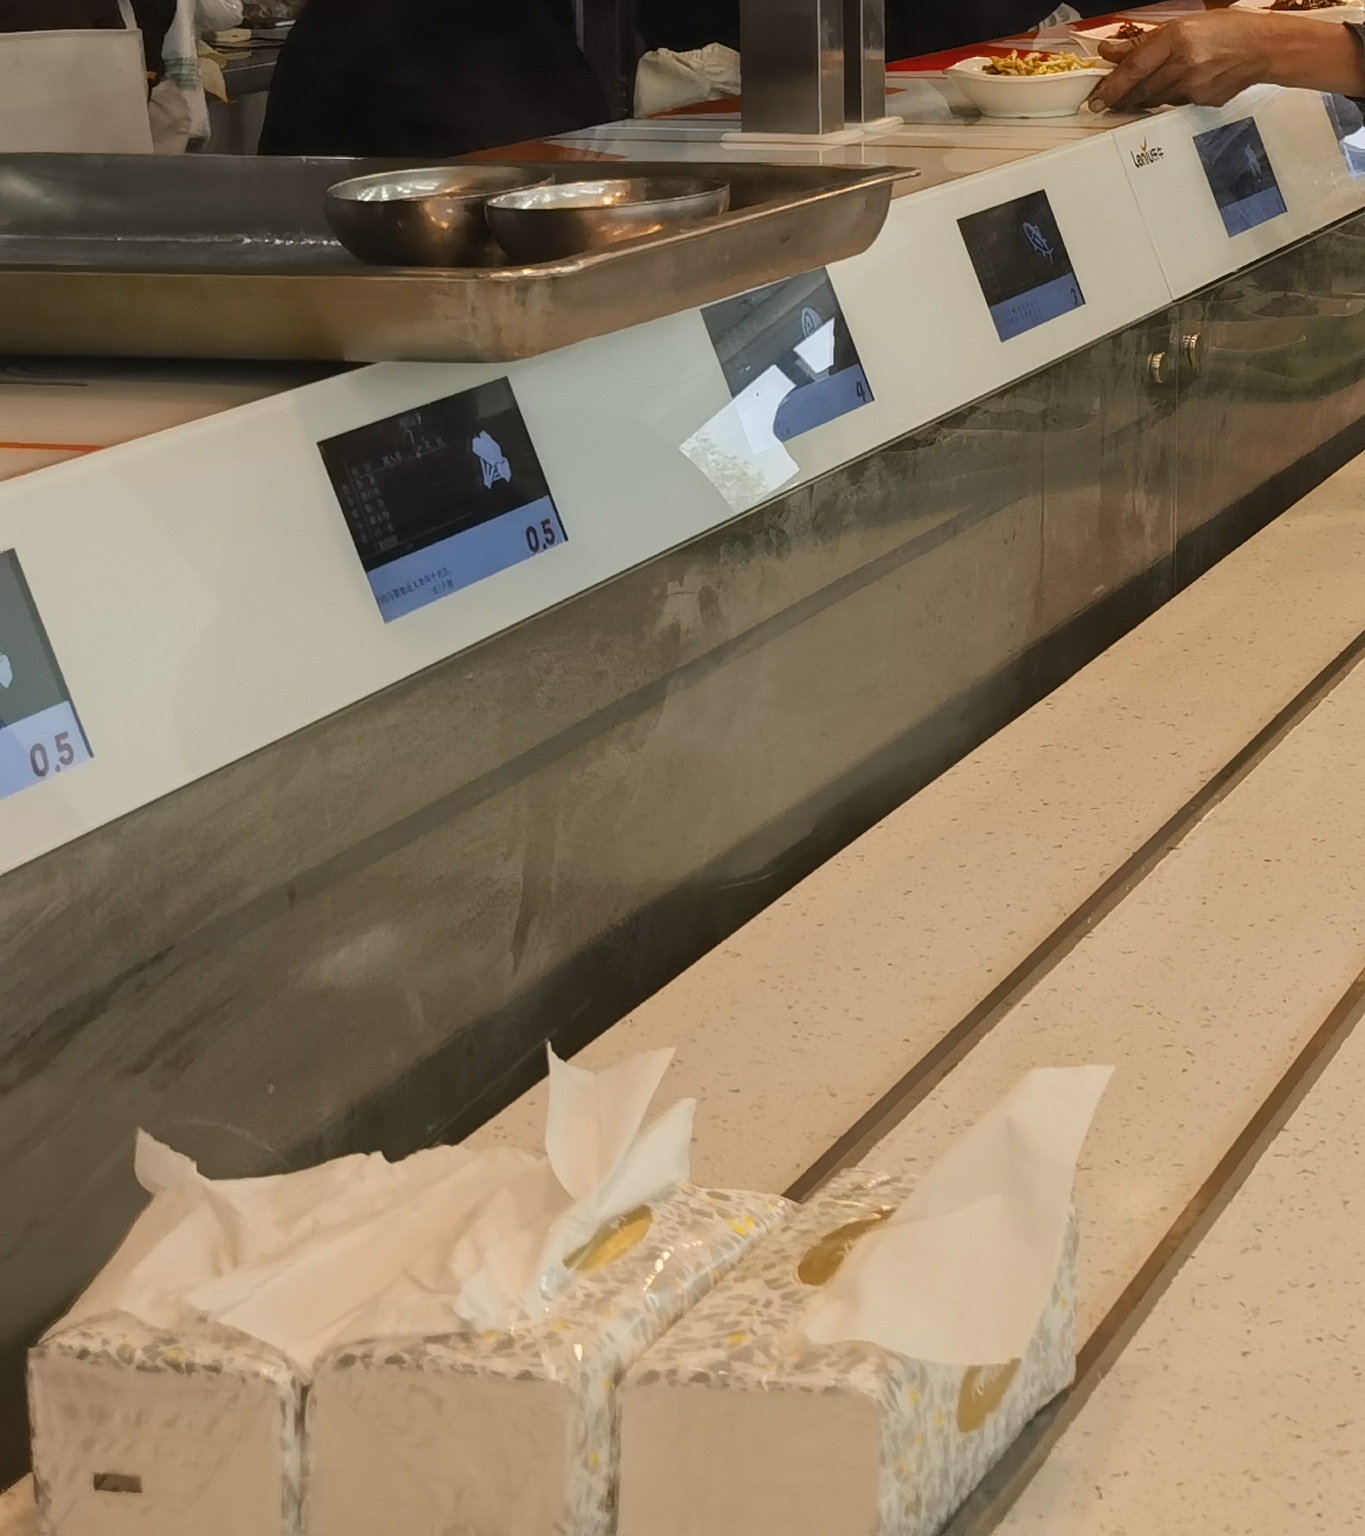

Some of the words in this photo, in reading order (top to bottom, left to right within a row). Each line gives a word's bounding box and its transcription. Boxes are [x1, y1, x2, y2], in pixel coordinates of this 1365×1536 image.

[856, 380, 867, 403] 4
[525, 518, 557, 555] 0.5
[29, 730, 75, 778] 0.5
